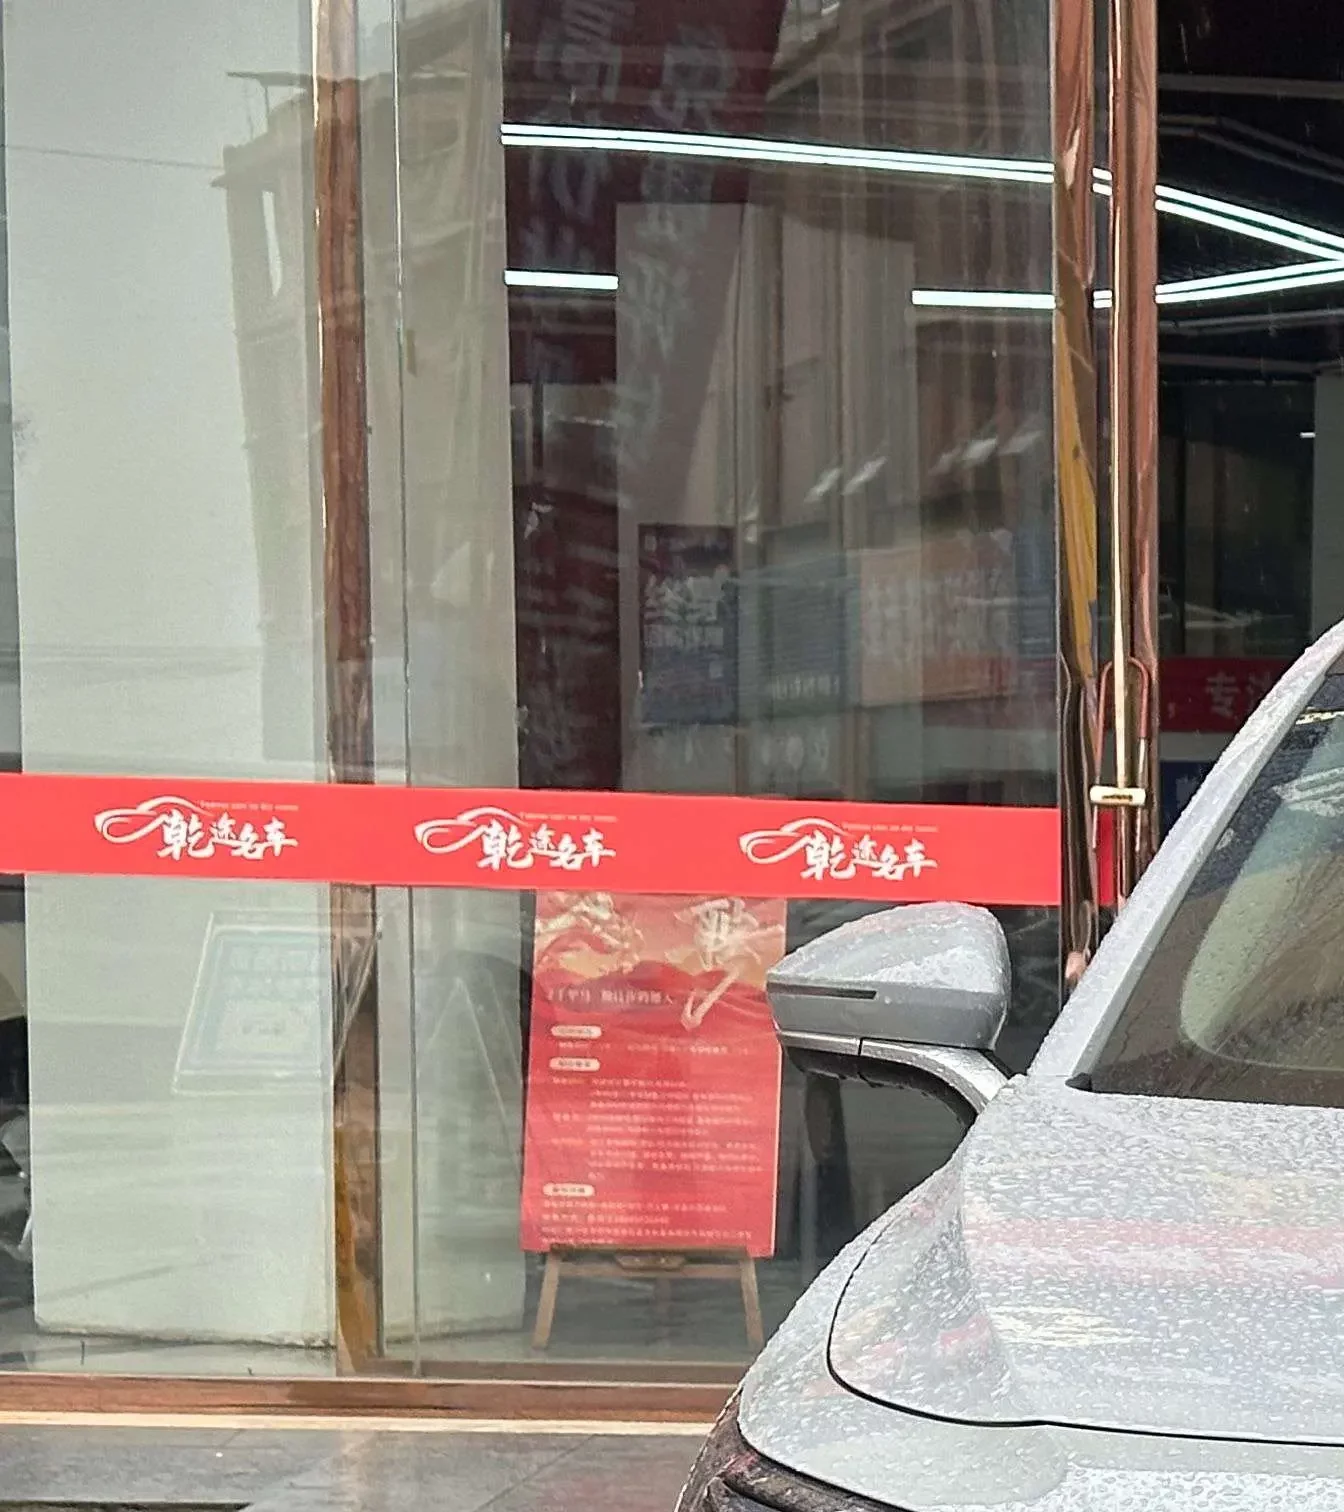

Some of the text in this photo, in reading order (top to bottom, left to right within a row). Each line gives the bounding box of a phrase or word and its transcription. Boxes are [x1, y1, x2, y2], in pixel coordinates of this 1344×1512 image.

[157, 807, 298, 861] 乾途名车
[477, 818, 617, 871] 乾途名车
[801, 828, 938, 881] 乾途名车
